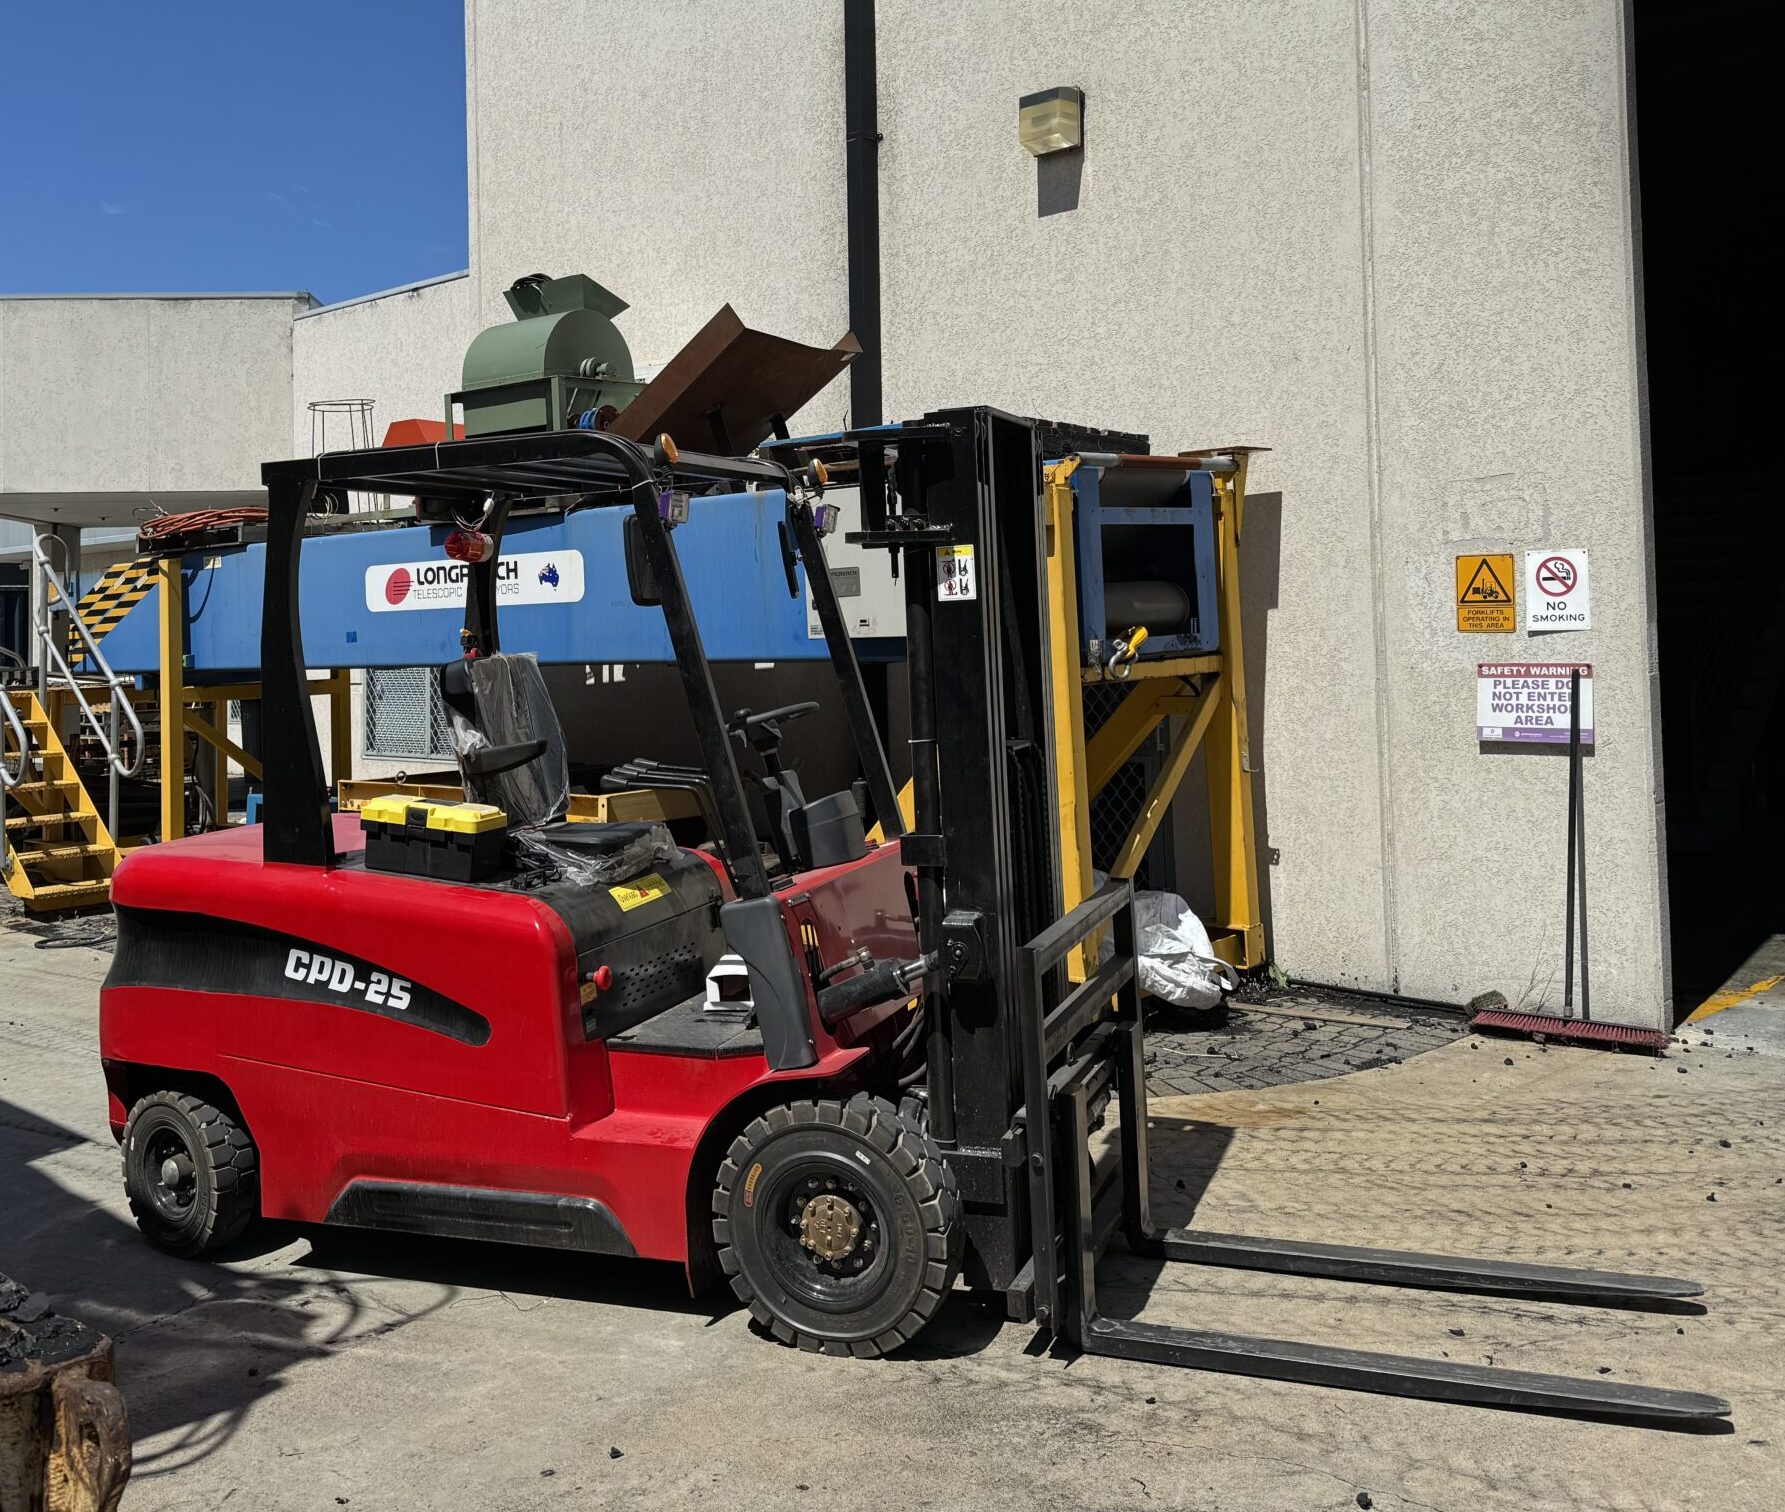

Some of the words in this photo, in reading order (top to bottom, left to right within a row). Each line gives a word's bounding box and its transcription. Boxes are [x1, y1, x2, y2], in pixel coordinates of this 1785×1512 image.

[417, 561, 518, 585] LONGRCH
[413, 587, 462, 599] TELESCOPIC
[1546, 601, 1567, 611] NO
[1532, 613, 1585, 622] SMOKING
[1482, 666, 1526, 675] SAFETY
[1530, 666, 1588, 676] WARNIG
[1493, 680, 1550, 690] PLEASE
[1492, 691, 1522, 702] NOT
[1491, 703, 1572, 714] WORKSHO
[1514, 715, 1554, 726] AREA
[285, 948, 412, 1010] CPD-25
